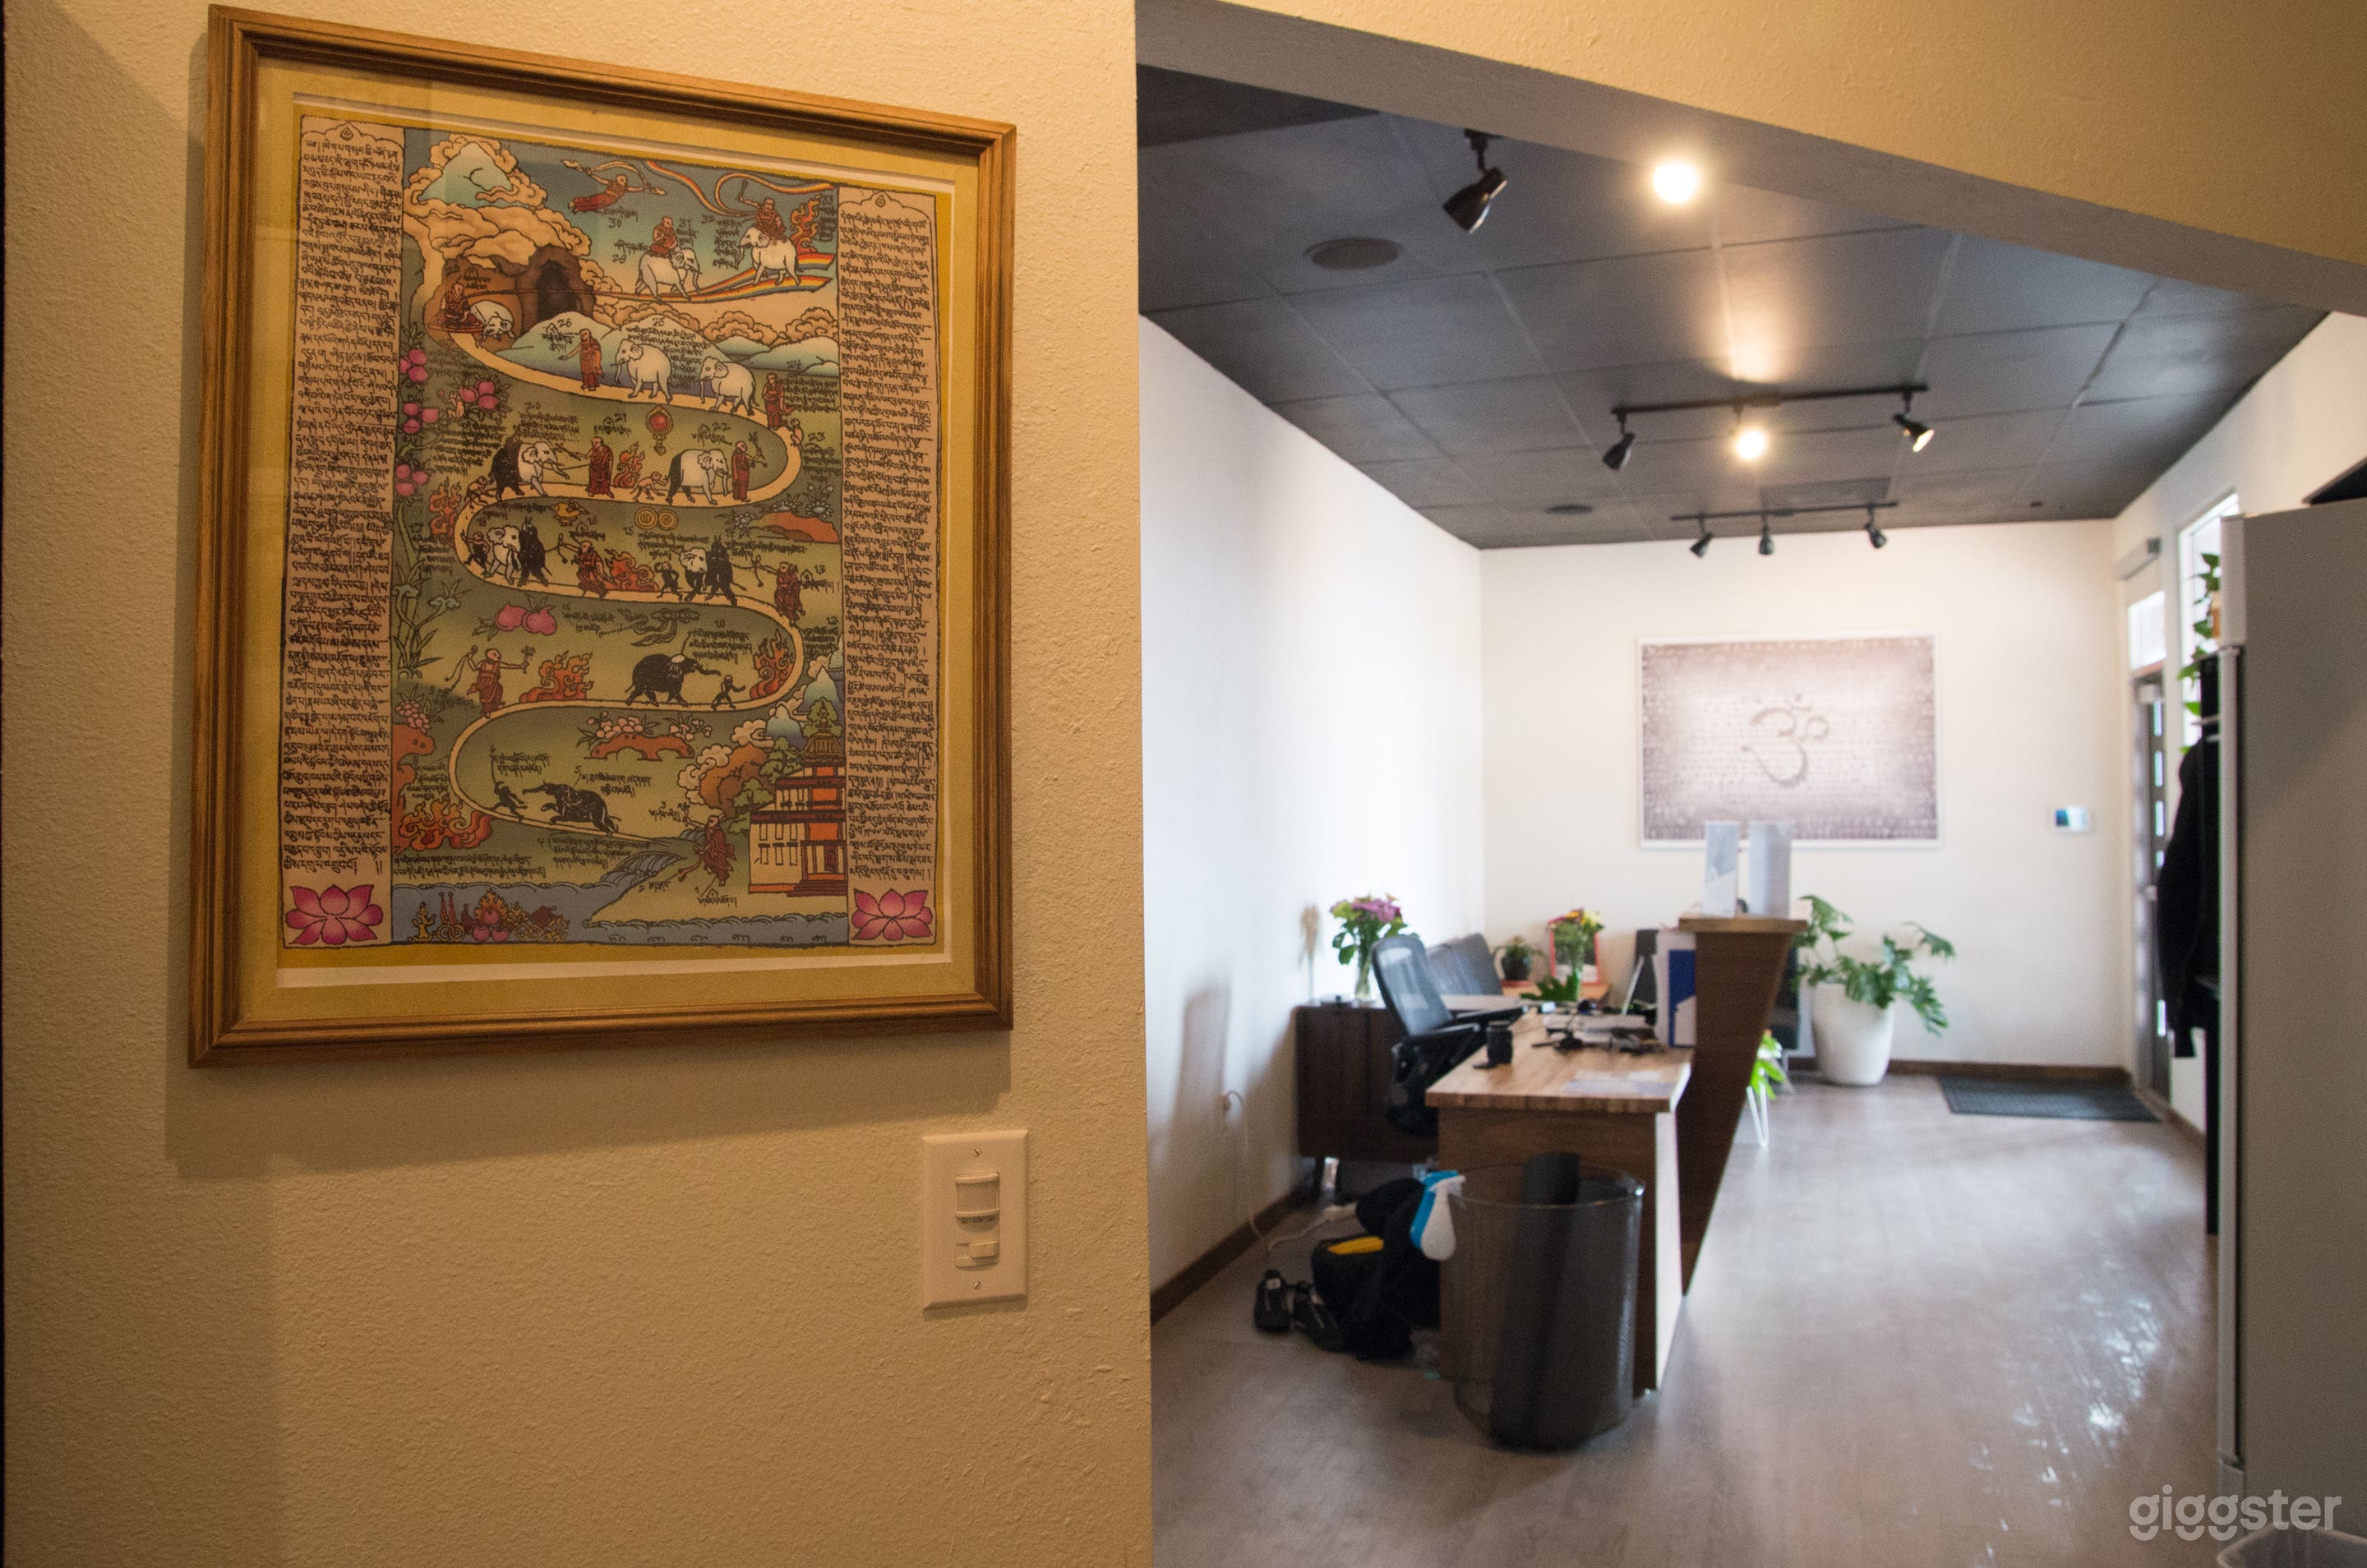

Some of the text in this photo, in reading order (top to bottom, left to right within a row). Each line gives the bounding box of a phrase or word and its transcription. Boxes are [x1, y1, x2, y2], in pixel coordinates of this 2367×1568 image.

[608, 217, 622, 228] 30
[556, 319, 572, 328] 26
[652, 317, 666, 326] 25
[614, 413, 627, 422] 21
[712, 422, 731, 431] 22
[807, 432, 825, 441] 23
[814, 565, 826, 574] 13
[714, 620, 725, 628] 10
[827, 616, 838, 625] 12
[661, 800, 667, 809] 3
